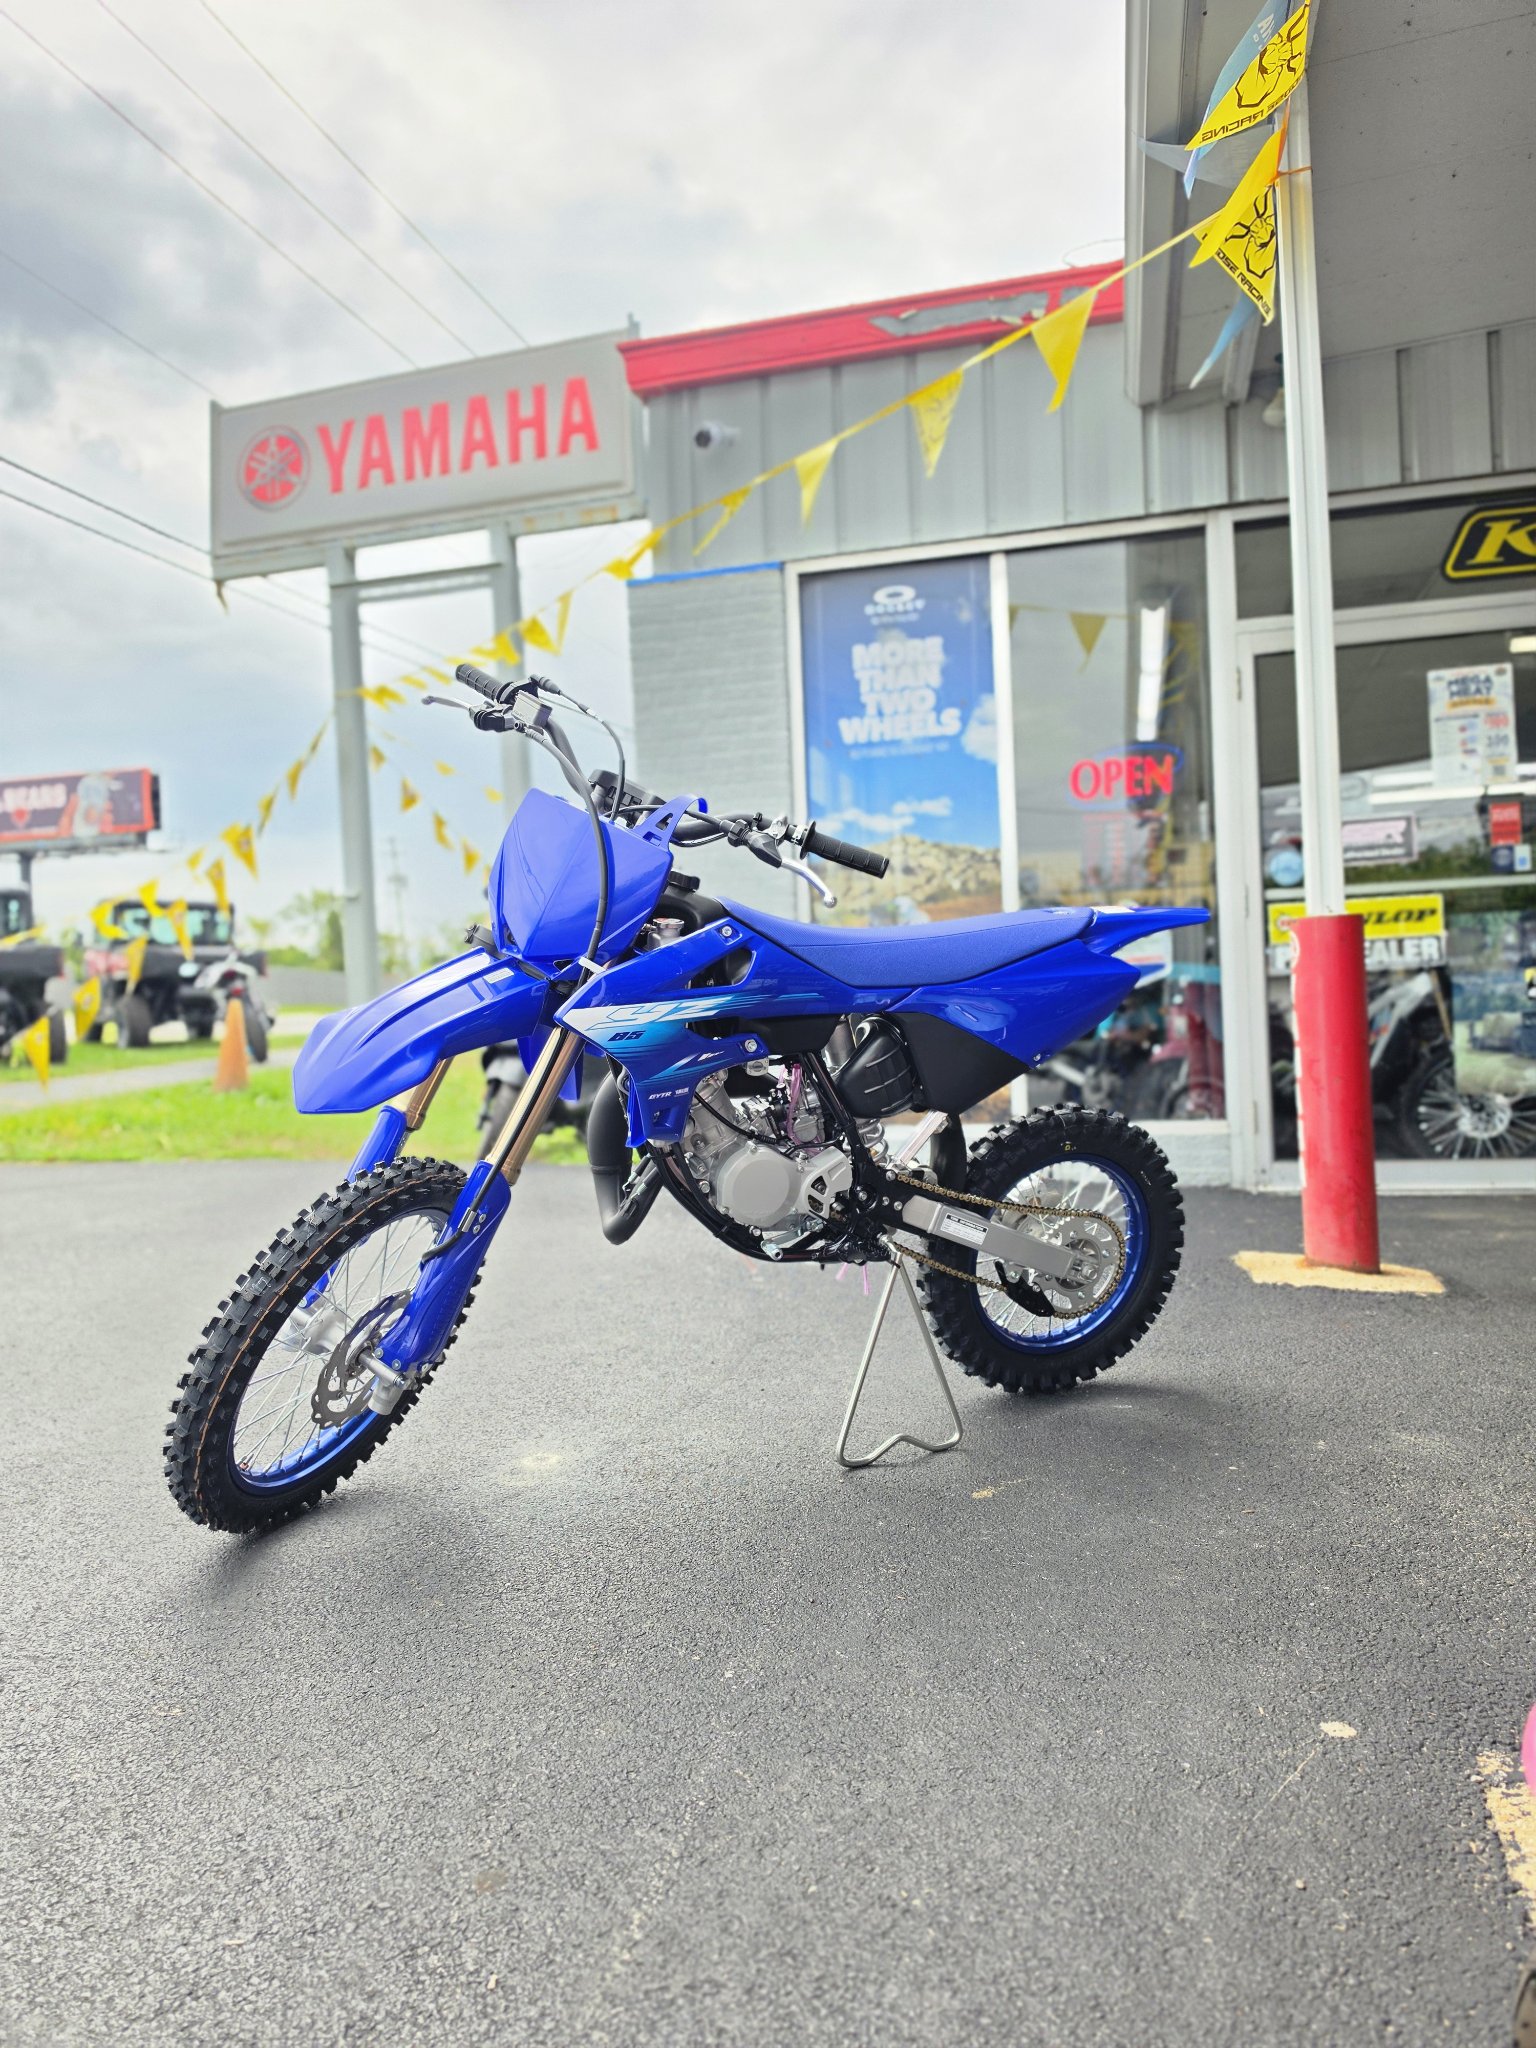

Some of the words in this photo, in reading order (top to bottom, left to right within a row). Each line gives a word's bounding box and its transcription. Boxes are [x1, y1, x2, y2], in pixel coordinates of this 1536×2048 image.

[1236, 272, 1271, 316] RACING
[316, 375, 599, 495] YAMAHA
[852, 636, 945, 669] MORE
[854, 660, 943, 695] THAN
[860, 688, 937, 717] TWO
[838, 707, 962, 746] WHEELS
[1069, 753, 1174, 801] OPEN
